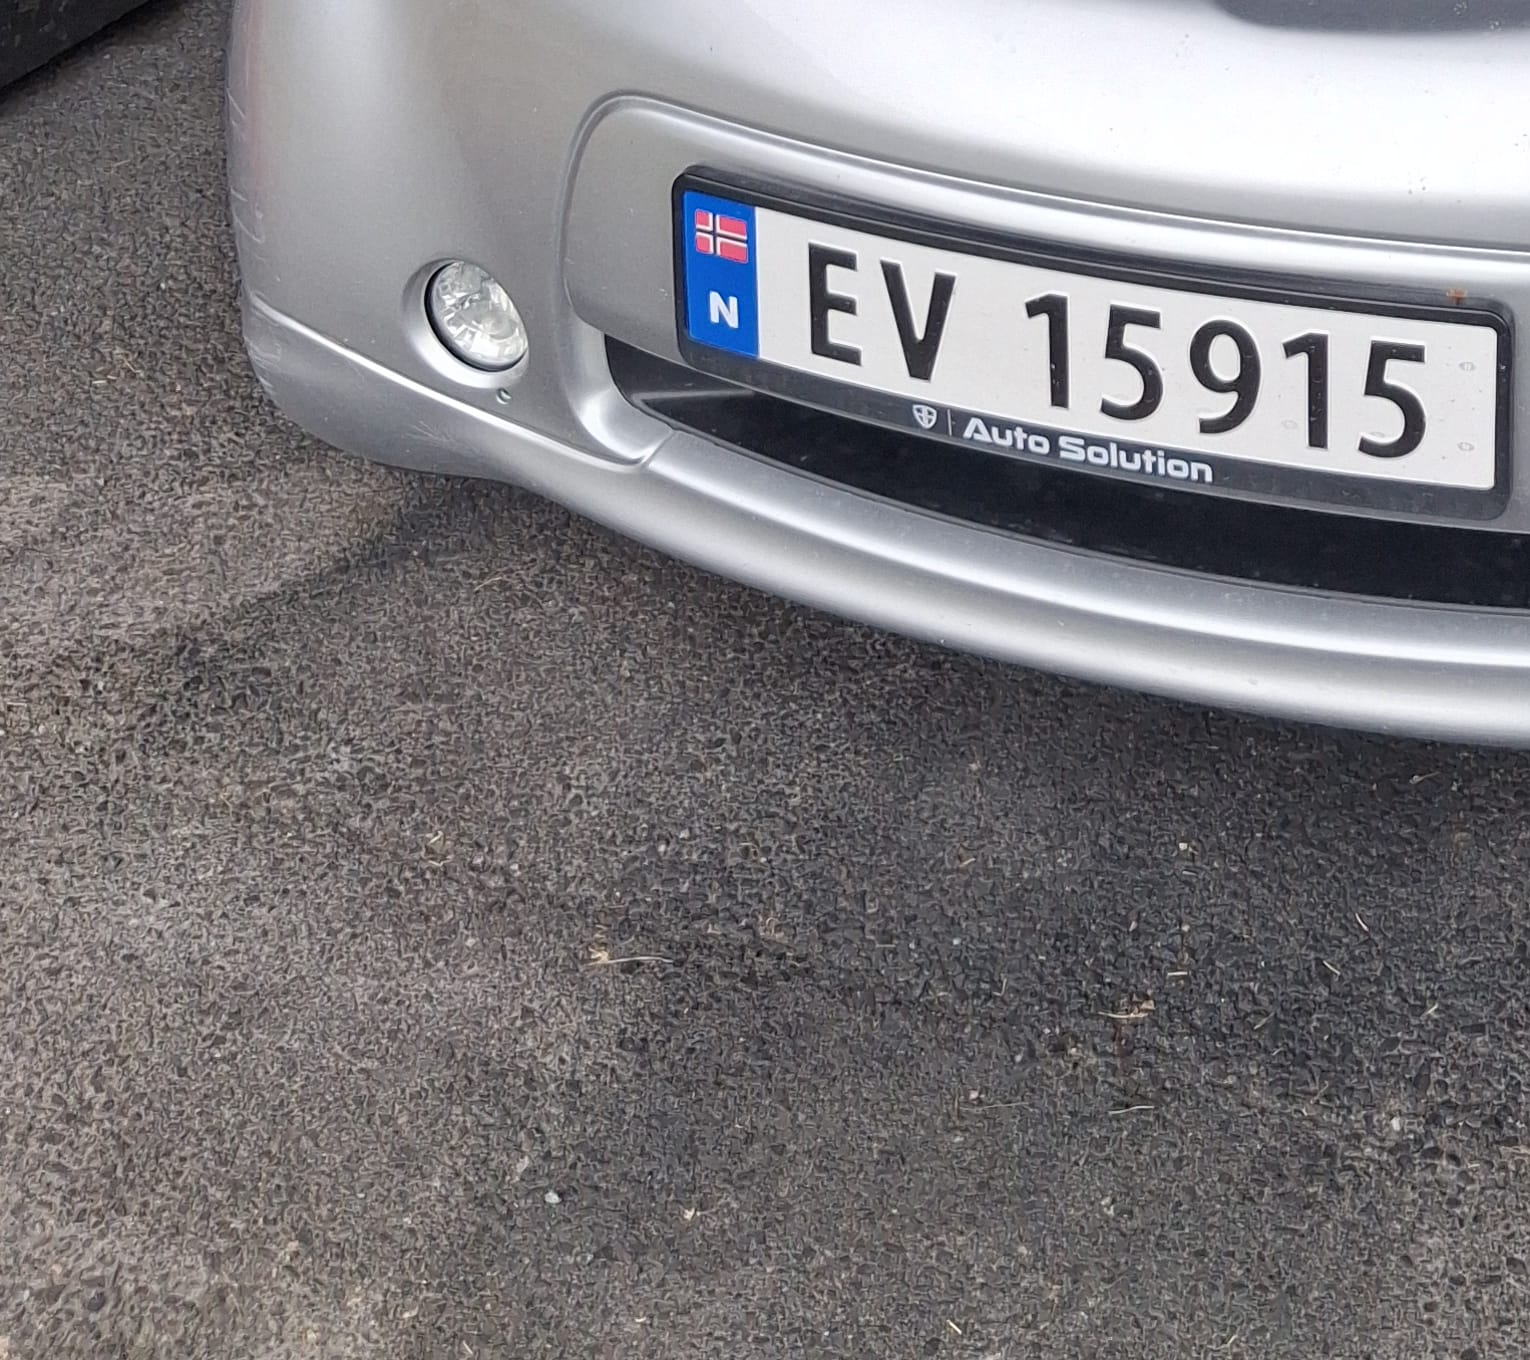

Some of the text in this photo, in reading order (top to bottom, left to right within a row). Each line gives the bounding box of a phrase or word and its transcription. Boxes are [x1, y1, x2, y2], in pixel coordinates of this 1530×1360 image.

[708, 292, 738, 328] N
[808, 241, 1427, 459] EV 15915
[962, 416, 1214, 484] Auto Solution
